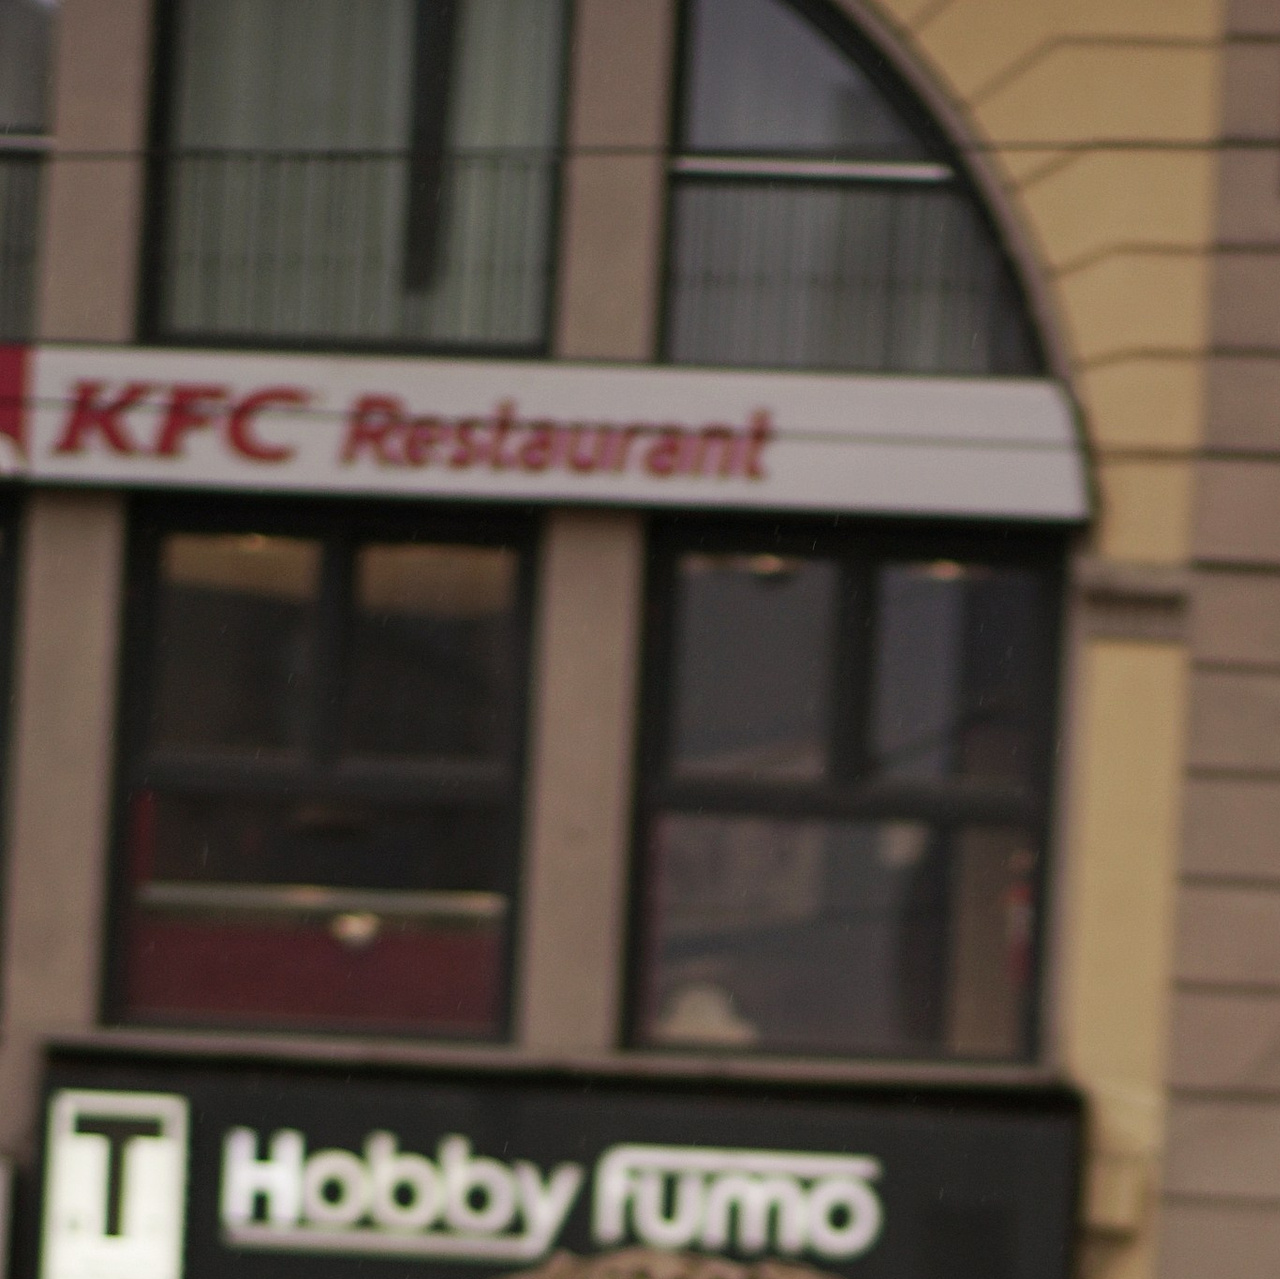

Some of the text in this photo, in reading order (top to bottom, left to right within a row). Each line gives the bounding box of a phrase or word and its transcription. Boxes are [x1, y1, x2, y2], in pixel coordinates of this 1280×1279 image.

[53, 378, 770, 480] KFC Restaurant
[74, 1115, 164, 1236] T
[222, 1126, 882, 1261] Hobby fumo
